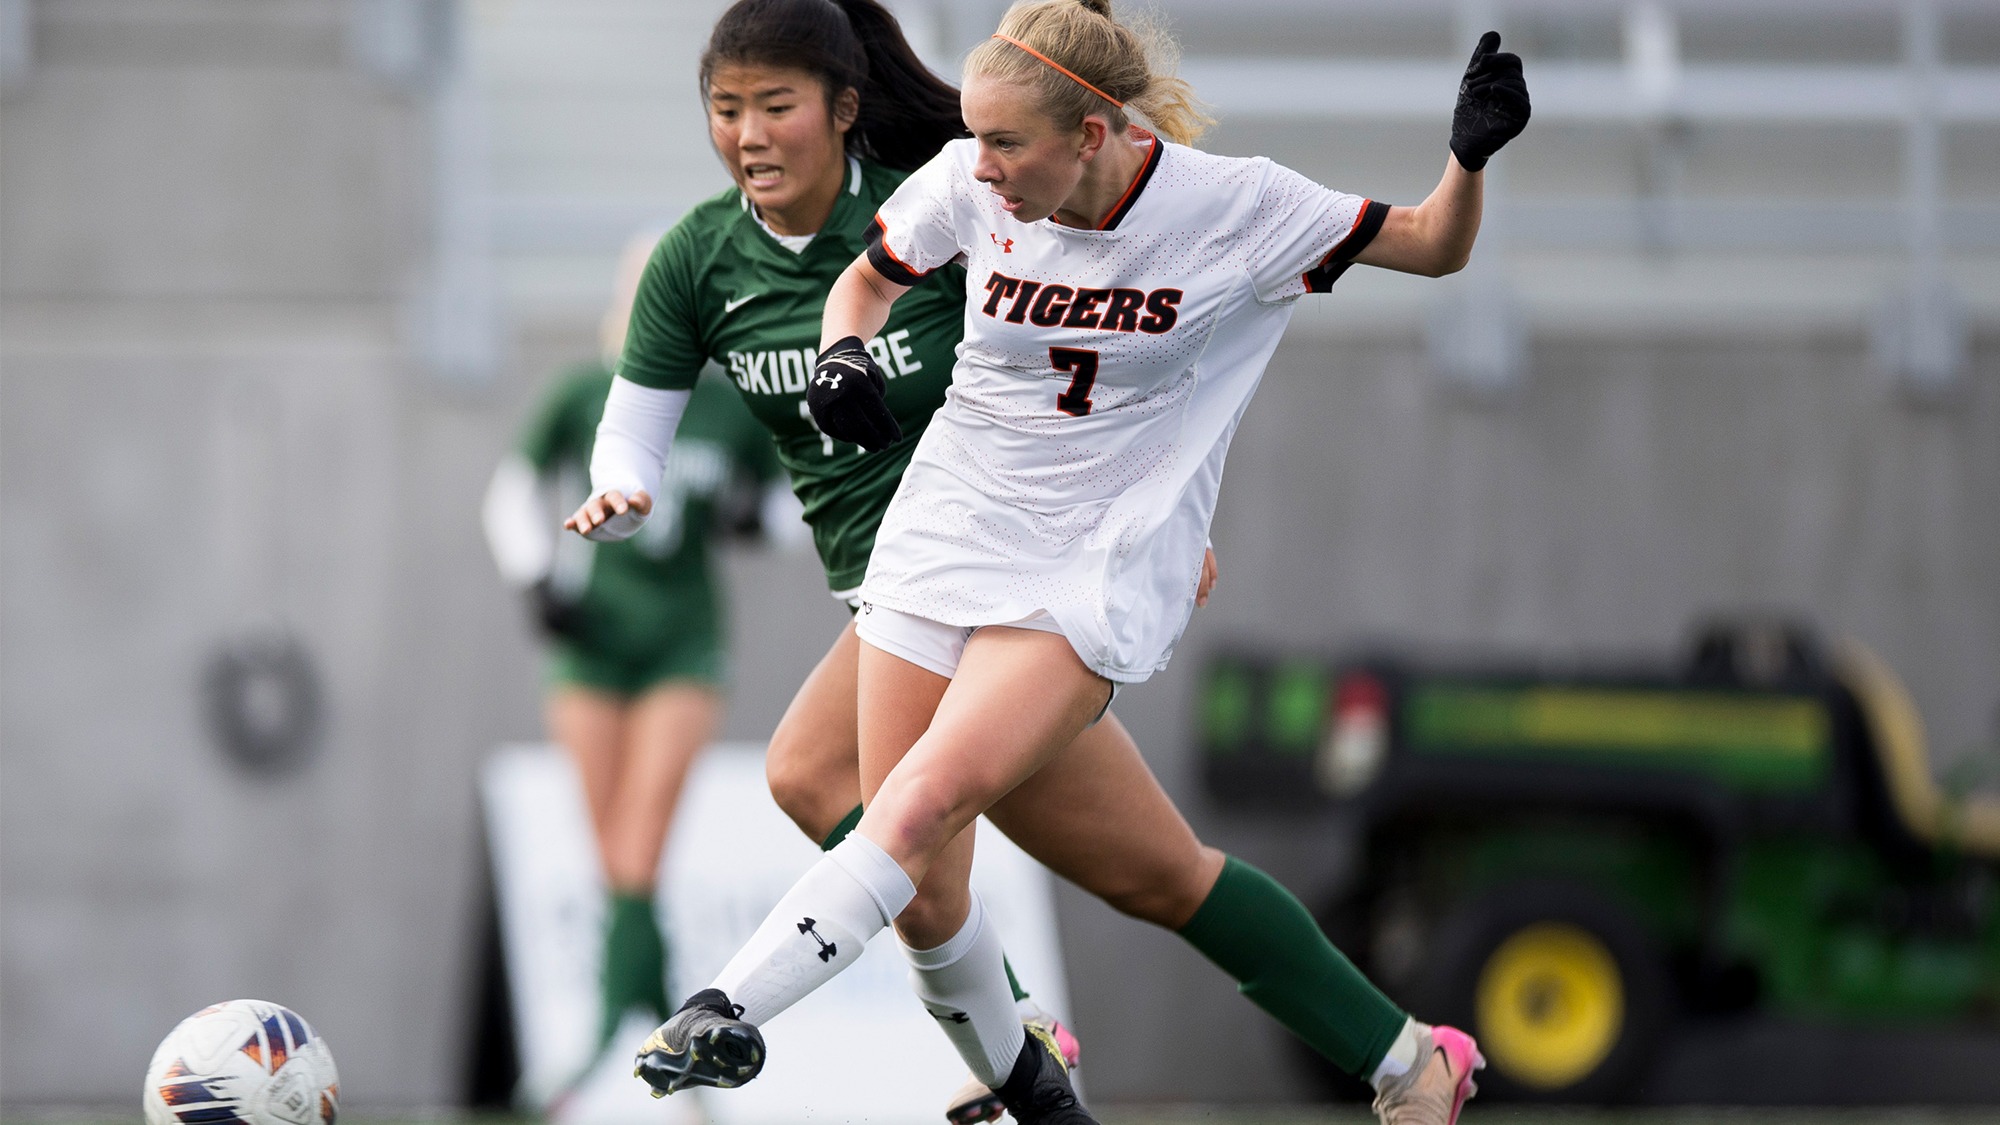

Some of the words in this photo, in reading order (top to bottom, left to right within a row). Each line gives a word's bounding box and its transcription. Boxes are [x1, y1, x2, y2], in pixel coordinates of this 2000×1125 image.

[982, 271, 1184, 334] TIGERS
[728, 329, 923, 395] SKIDRE
[1048, 346, 1099, 417] 7
